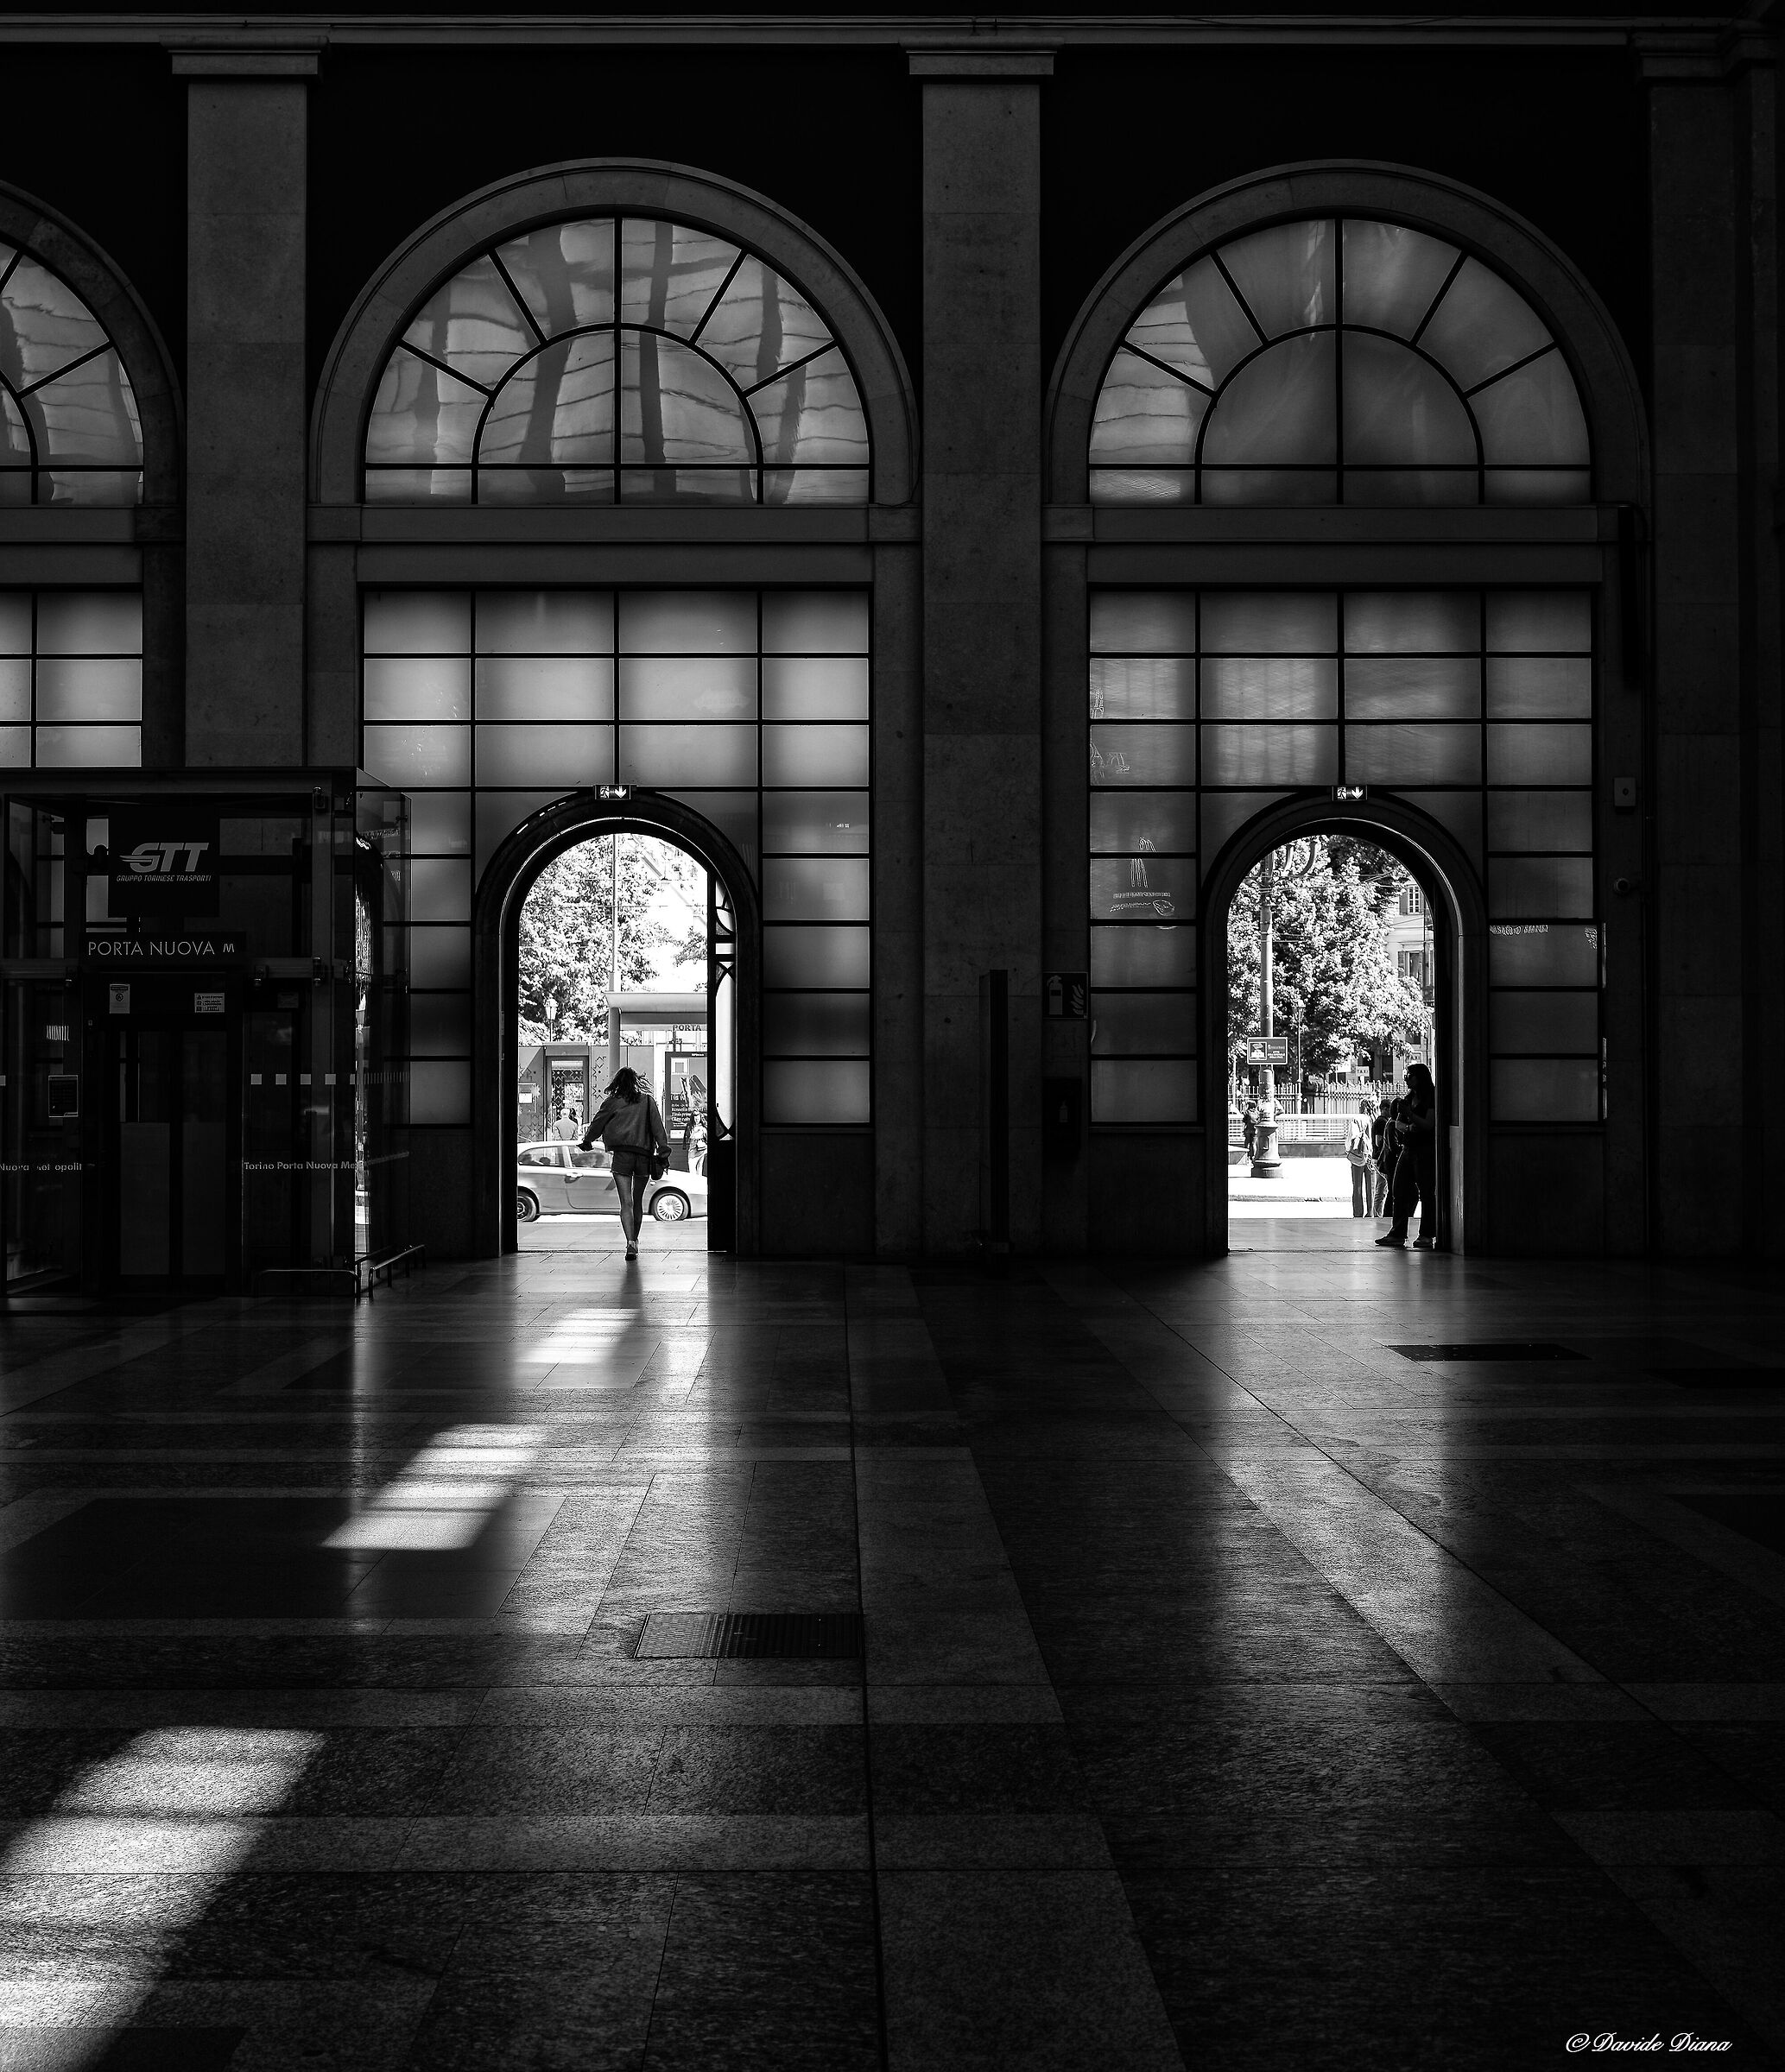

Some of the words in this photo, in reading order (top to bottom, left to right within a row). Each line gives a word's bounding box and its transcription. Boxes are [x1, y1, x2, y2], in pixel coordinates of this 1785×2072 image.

[119, 843, 209, 873] GTT
[88, 941, 143, 956] PORTA
[149, 941, 215, 956] NUOVA
[244, 1161, 275, 1170] Torino
[276, 1161, 303, 1170] Porta
[306, 1160, 339, 1170] Nuova
